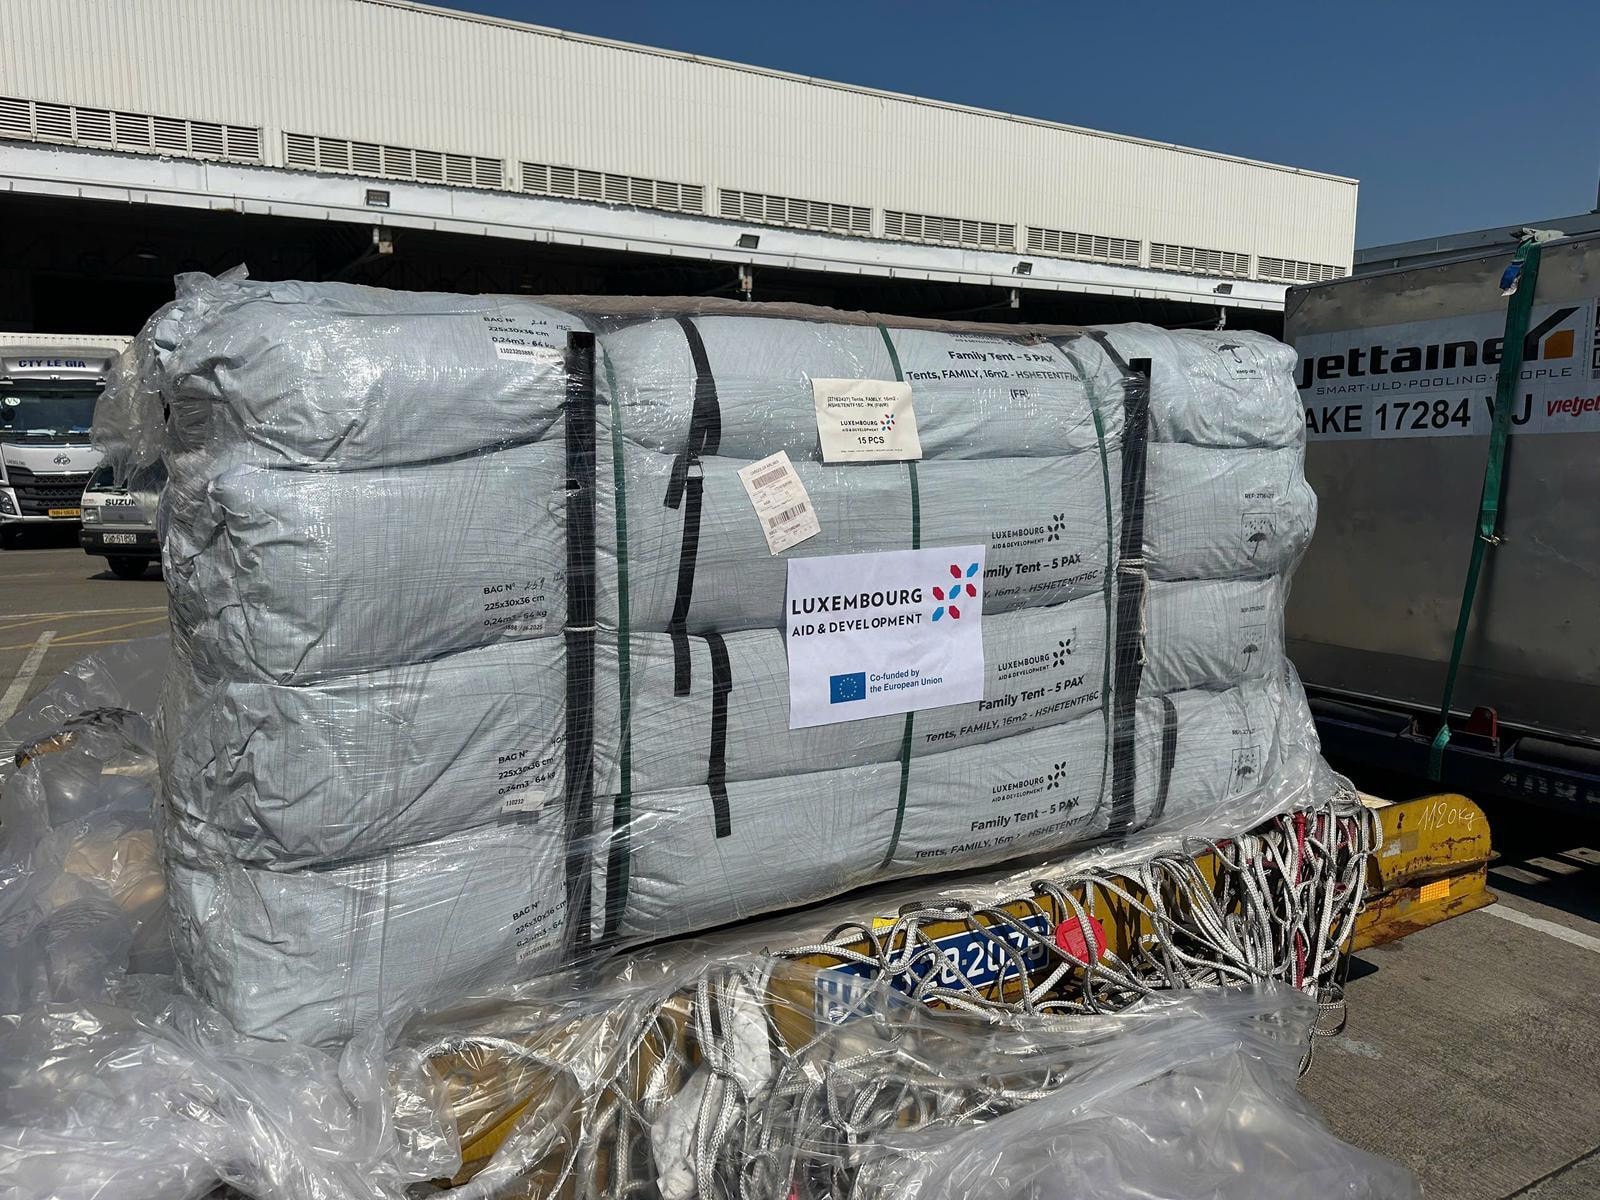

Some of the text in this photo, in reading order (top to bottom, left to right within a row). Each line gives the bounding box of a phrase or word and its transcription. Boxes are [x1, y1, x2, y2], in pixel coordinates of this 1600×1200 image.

[18, 359, 43, 368] CTY
[65, 360, 86, 368] GIA
[947, 351, 986, 362] Family
[987, 352, 1015, 361] Tent
[1023, 353, 1032, 361] 5
[1032, 353, 1055, 363] PAX
[906, 371, 941, 381] Tents,
[941, 369, 983, 380] FAMILY,
[983, 369, 1009, 379] 16m2
[1304, 404, 1363, 434] AKE
[1375, 397, 1471, 431] 17284
[868, 436, 885, 444] PCS
[991, 526, 1044, 540] LUXEMBOURG
[1006, 538, 1044, 548] DEVELOPMENT
[1015, 562, 1041, 574] Tent
[1051, 558, 1058, 569] 5
[1061, 553, 1081, 567] PAX
[483, 585, 503, 595] BAG
[484, 595, 545, 611] 225x30x36 cm
[792, 588, 923, 615] LUXEMBOURG
[523, 611, 535, 619] 64
[792, 613, 922, 637] AID & DEVELOPMENT
[998, 653, 1050, 671] LUXEMBOURG
[869, 668, 920, 682] Co-funded by
[1012, 664, 1050, 678] DEVELOPMENT
[869, 677, 943, 693] the European Union
[978, 694, 1018, 712] Family
[1020, 687, 1045, 702] Tent
[1055, 682, 1062, 693] 5
[1063, 674, 1085, 690] PAX
[925, 729, 957, 744] Tents,
[959, 719, 1000, 736] FAMILY,
[1002, 712, 1028, 726] 16m2
[1035, 690, 1099, 718] HSHETENTF16C
[498, 753, 517, 764] BAG
[498, 757, 554, 780] 225x30x36 cm
[535, 774, 546, 783] 64
[992, 776, 1044, 794] LUXEMBOURG
[1006, 787, 1044, 800] DEVELOPMENT
[970, 815, 1011, 831] Family
[1013, 809, 1039, 823] Tent
[1049, 804, 1056, 815] 5
[1058, 796, 1080, 812] PAX
[915, 848, 947, 859] Tents,
[950, 839, 991, 854] FAMILY,
[512, 906, 531, 921] BAG
